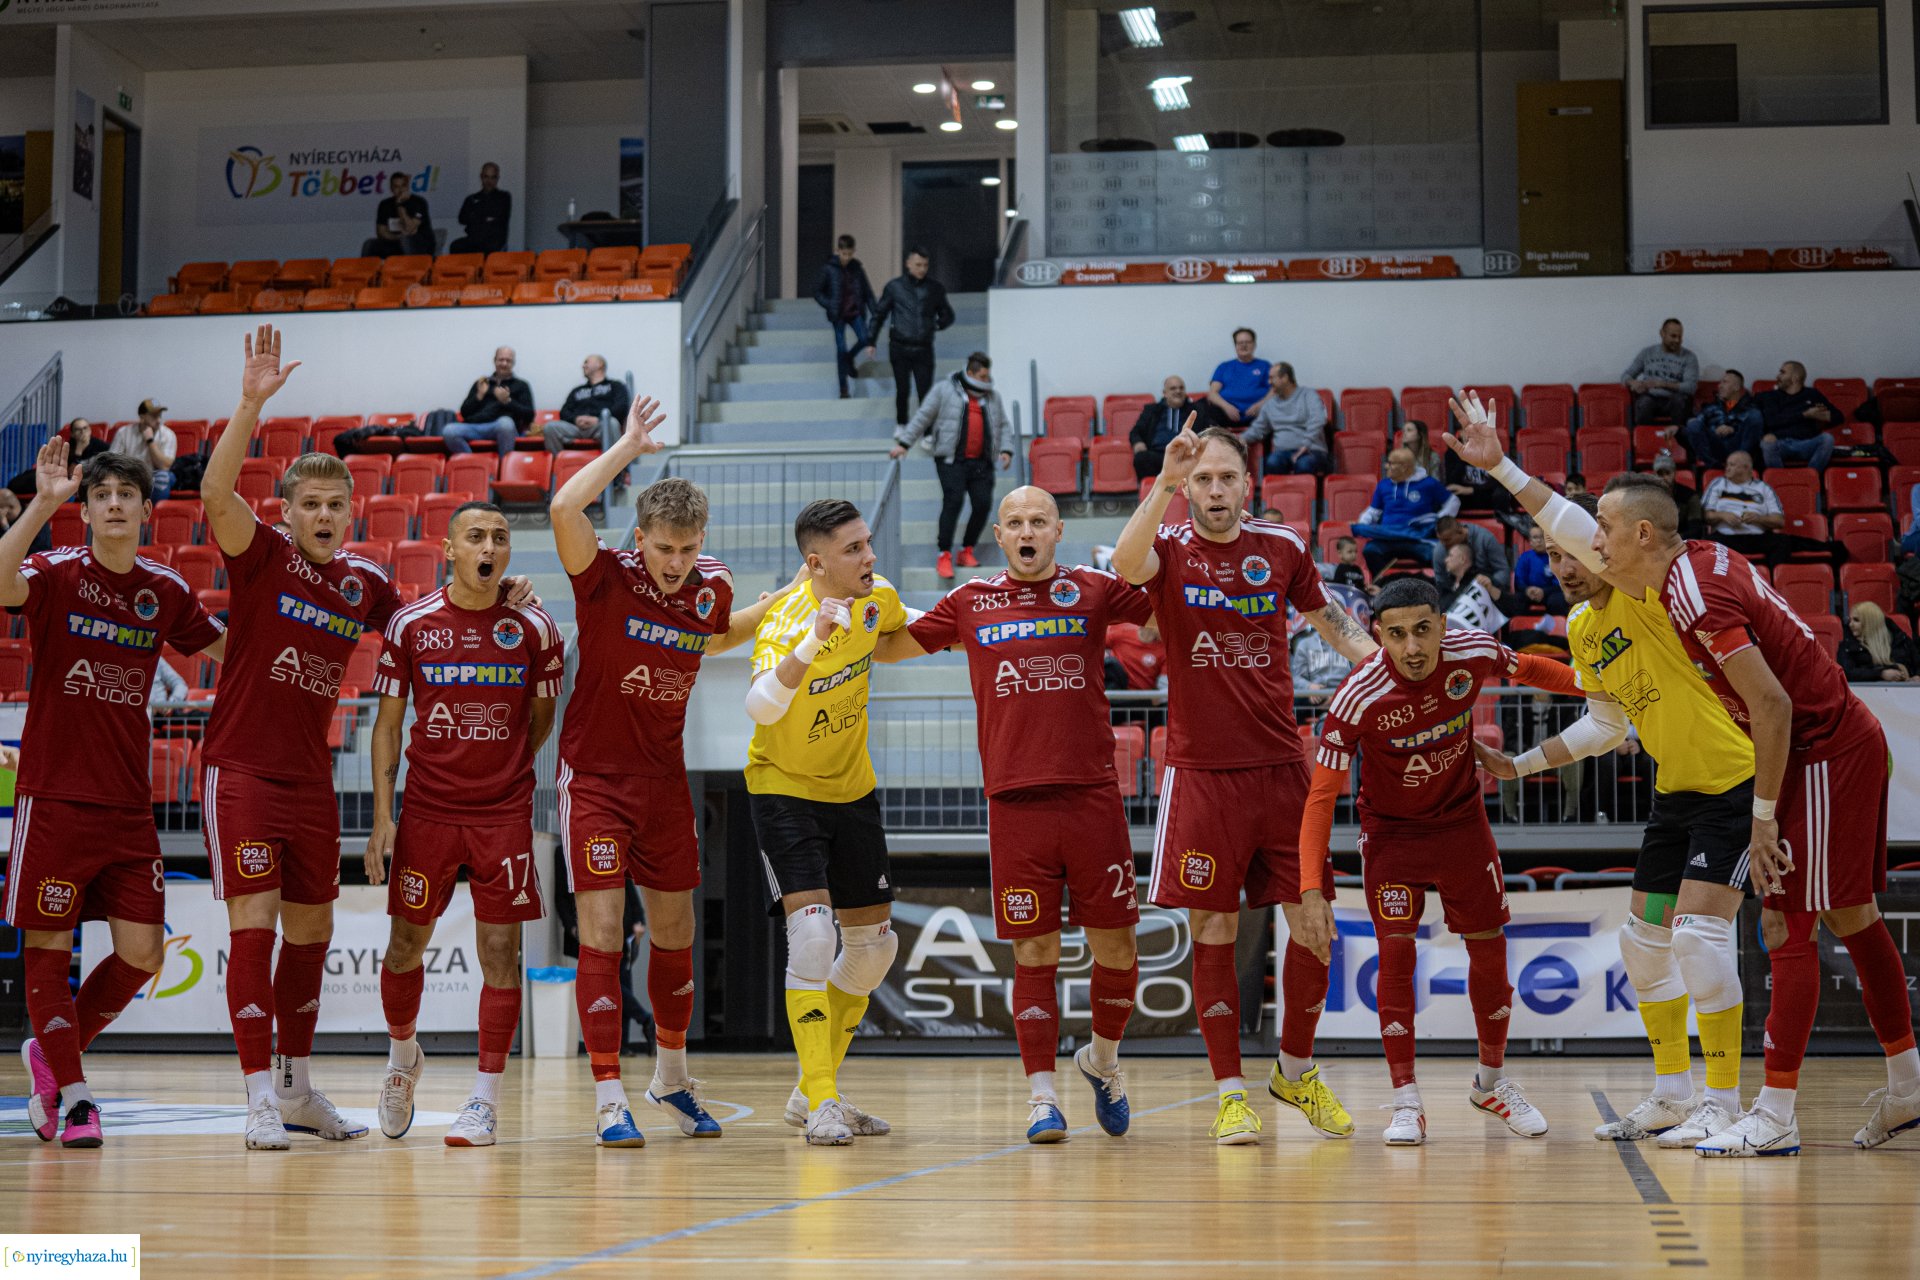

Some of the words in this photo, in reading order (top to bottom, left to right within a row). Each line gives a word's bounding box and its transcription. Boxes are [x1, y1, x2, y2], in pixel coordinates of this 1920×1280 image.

[289, 168, 387, 198] Többet
[972, 592, 1011, 612] 383
[416, 628, 453, 650] 383
[1191, 653, 1271, 668] STUDIO
[270, 666, 340, 698] STUDIO
[995, 676, 1086, 698] STUDIO
[64, 680, 143, 706] STUDIO
[620, 681, 690, 701] STUDIO
[1377, 705, 1415, 731] 383
[426, 724, 510, 740] STUDIO
[1391, 710, 1472, 748] TiPPMI
[242, 848, 267, 859] 99.4
[592, 843, 615, 855] 99.4
[250, 864, 264, 873] FM
[501, 852, 530, 891] 17
[598, 861, 612, 870] FM
[1188, 857, 1210, 871] 99.4
[152, 860, 165, 892] 8
[1107, 859, 1136, 899] 23
[1190, 876, 1203, 885] FM
[46, 885, 71, 899] 99.4
[1383, 890, 1407, 902] 99.4
[48, 903, 62, 912] FM
[1007, 894, 1032, 906] 99.4
[1014, 911, 1028, 920] FM
[1390, 907, 1404, 915] FM
